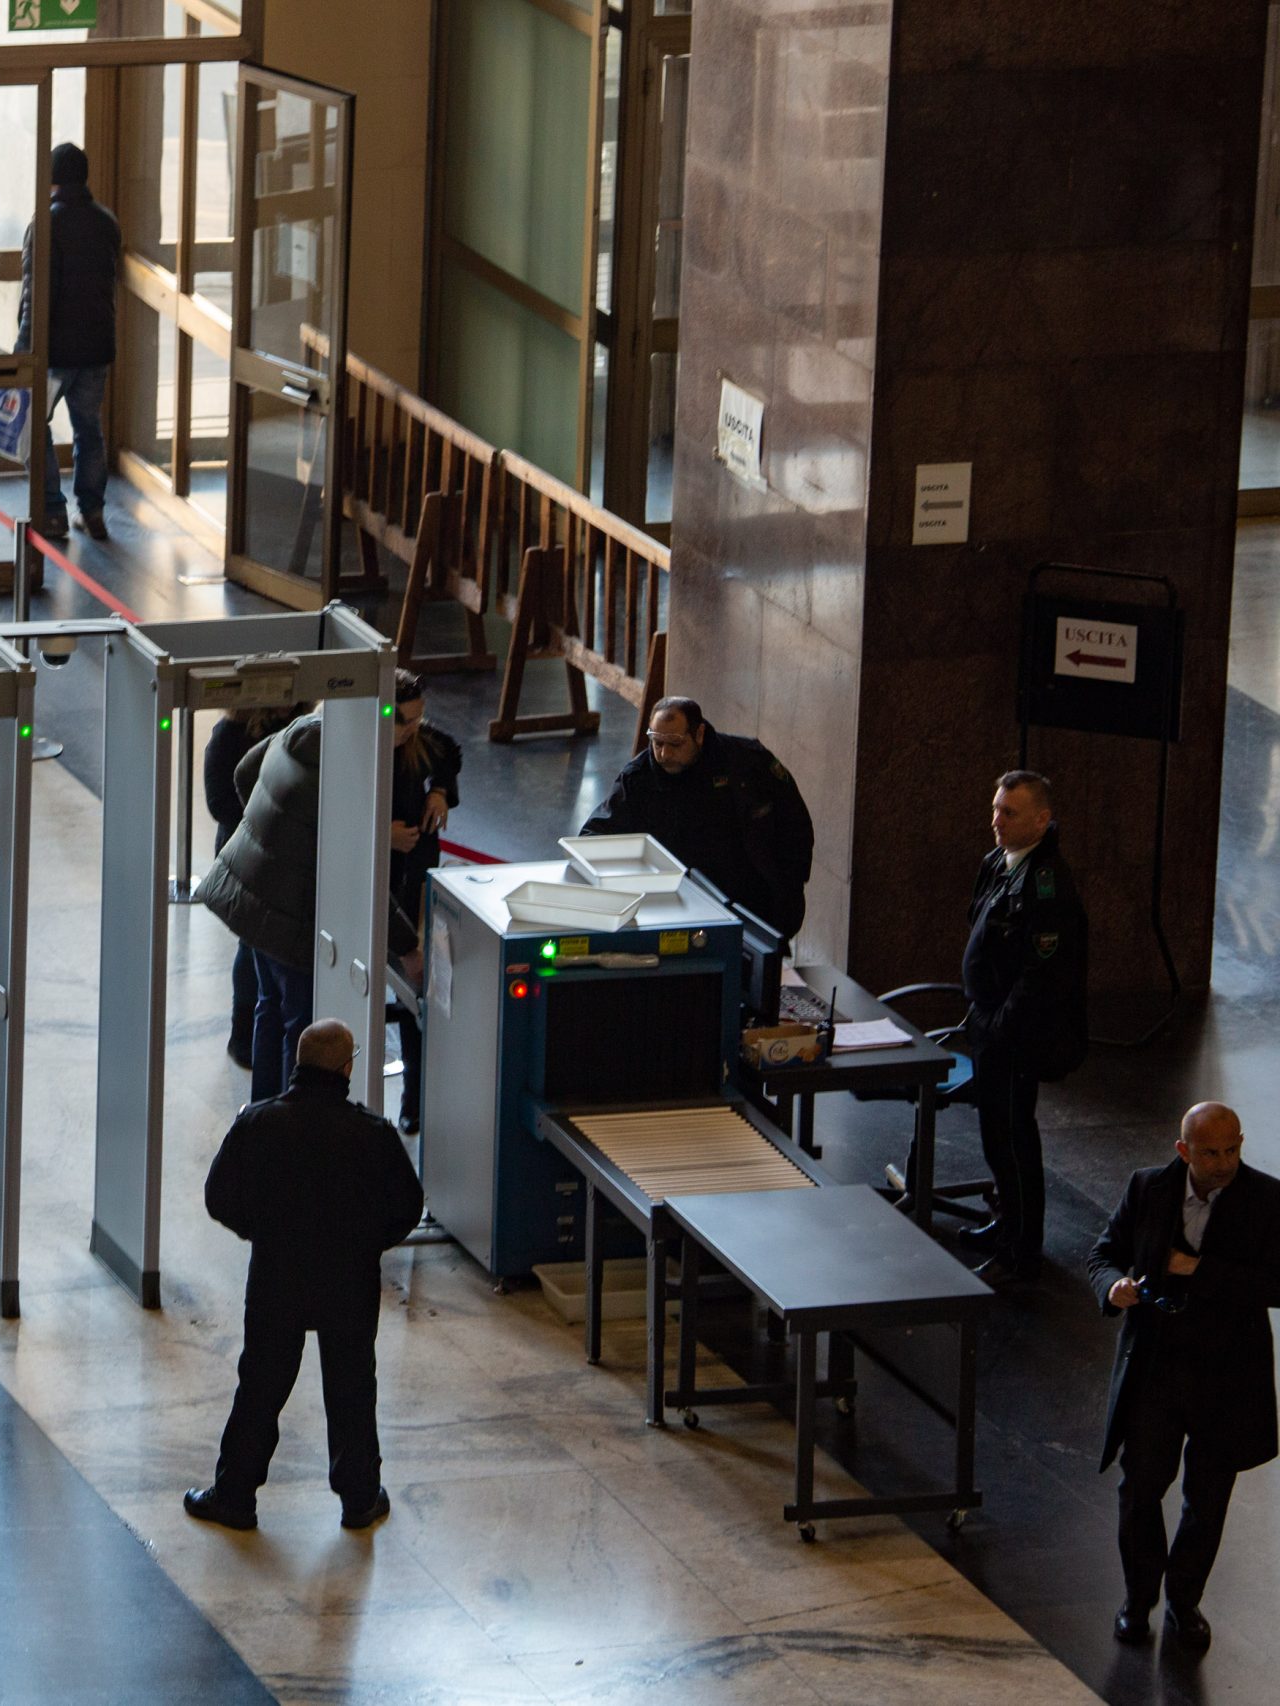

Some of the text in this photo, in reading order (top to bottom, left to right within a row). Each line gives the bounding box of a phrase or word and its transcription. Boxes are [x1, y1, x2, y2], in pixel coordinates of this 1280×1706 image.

[724, 411, 755, 443] USCITA
[920, 483, 949, 492] USCITA
[918, 519, 947, 529] USCITA
[1064, 626, 1129, 648] USCITA
